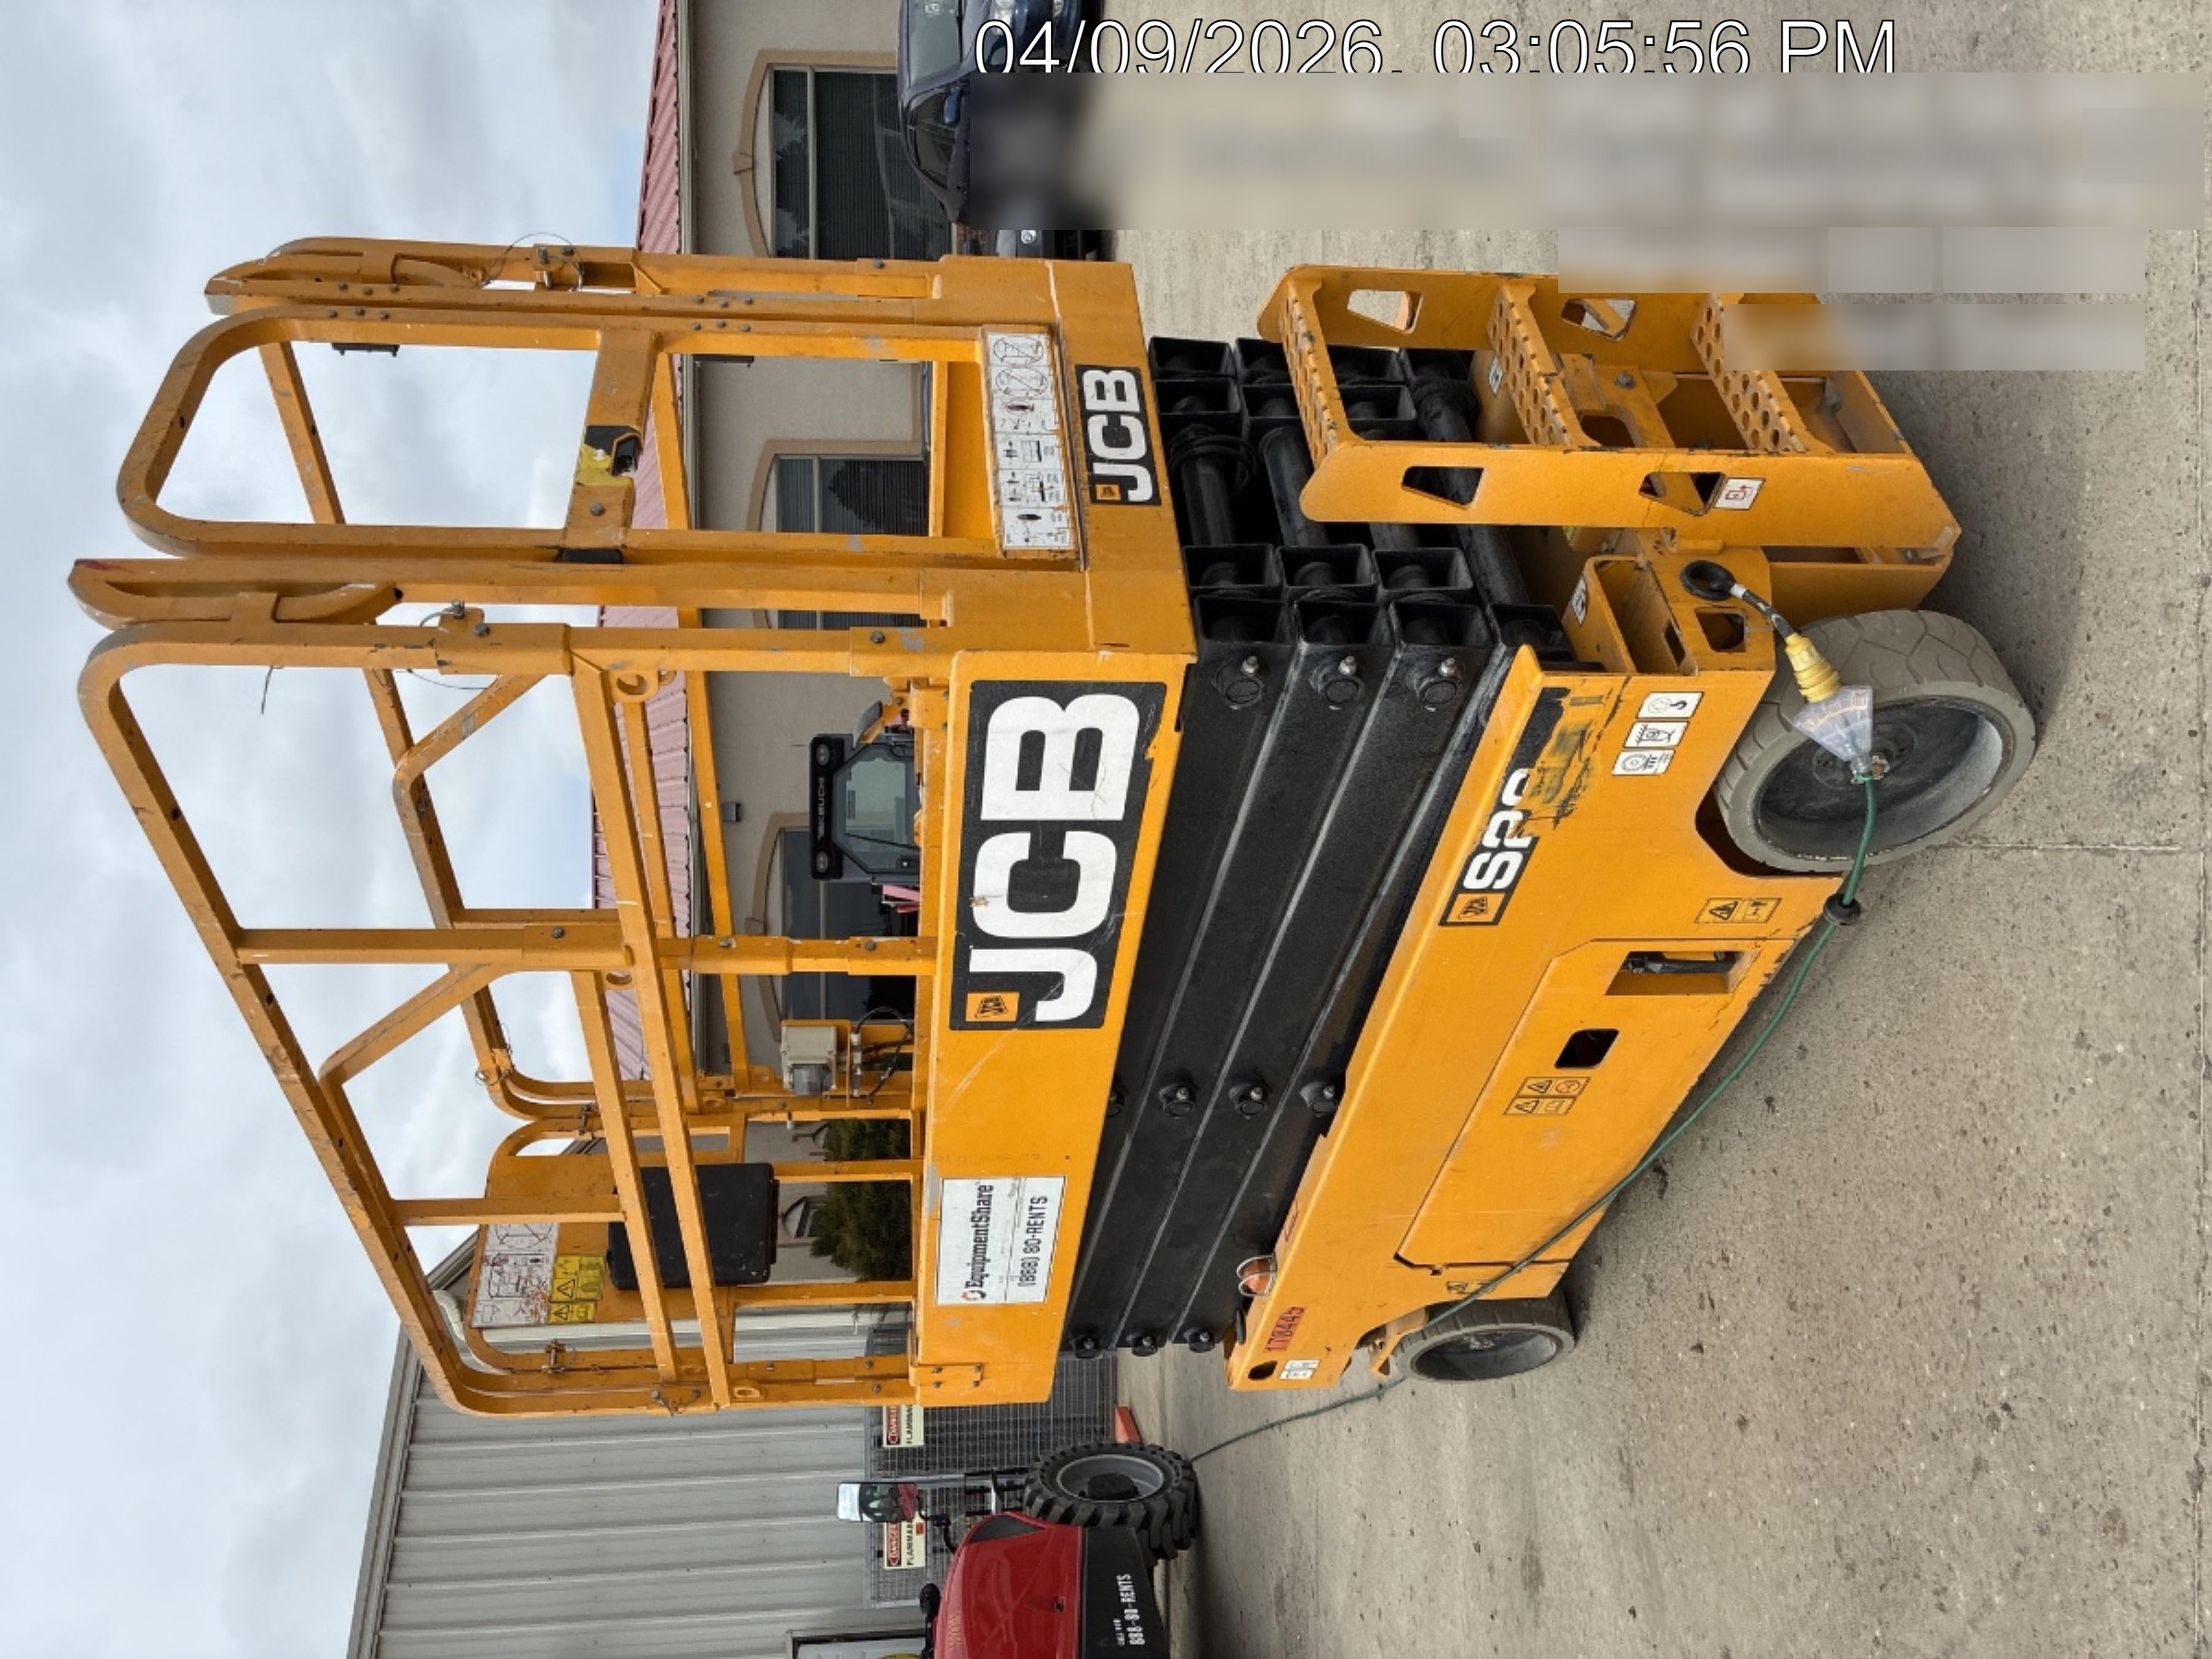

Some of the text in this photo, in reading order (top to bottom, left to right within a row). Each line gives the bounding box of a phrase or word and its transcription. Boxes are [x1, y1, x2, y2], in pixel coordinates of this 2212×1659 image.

[1082, 369, 1153, 502] JCB
[968, 693, 1140, 1022] JCB
[965, 1185, 994, 1289] EquipmentShare
